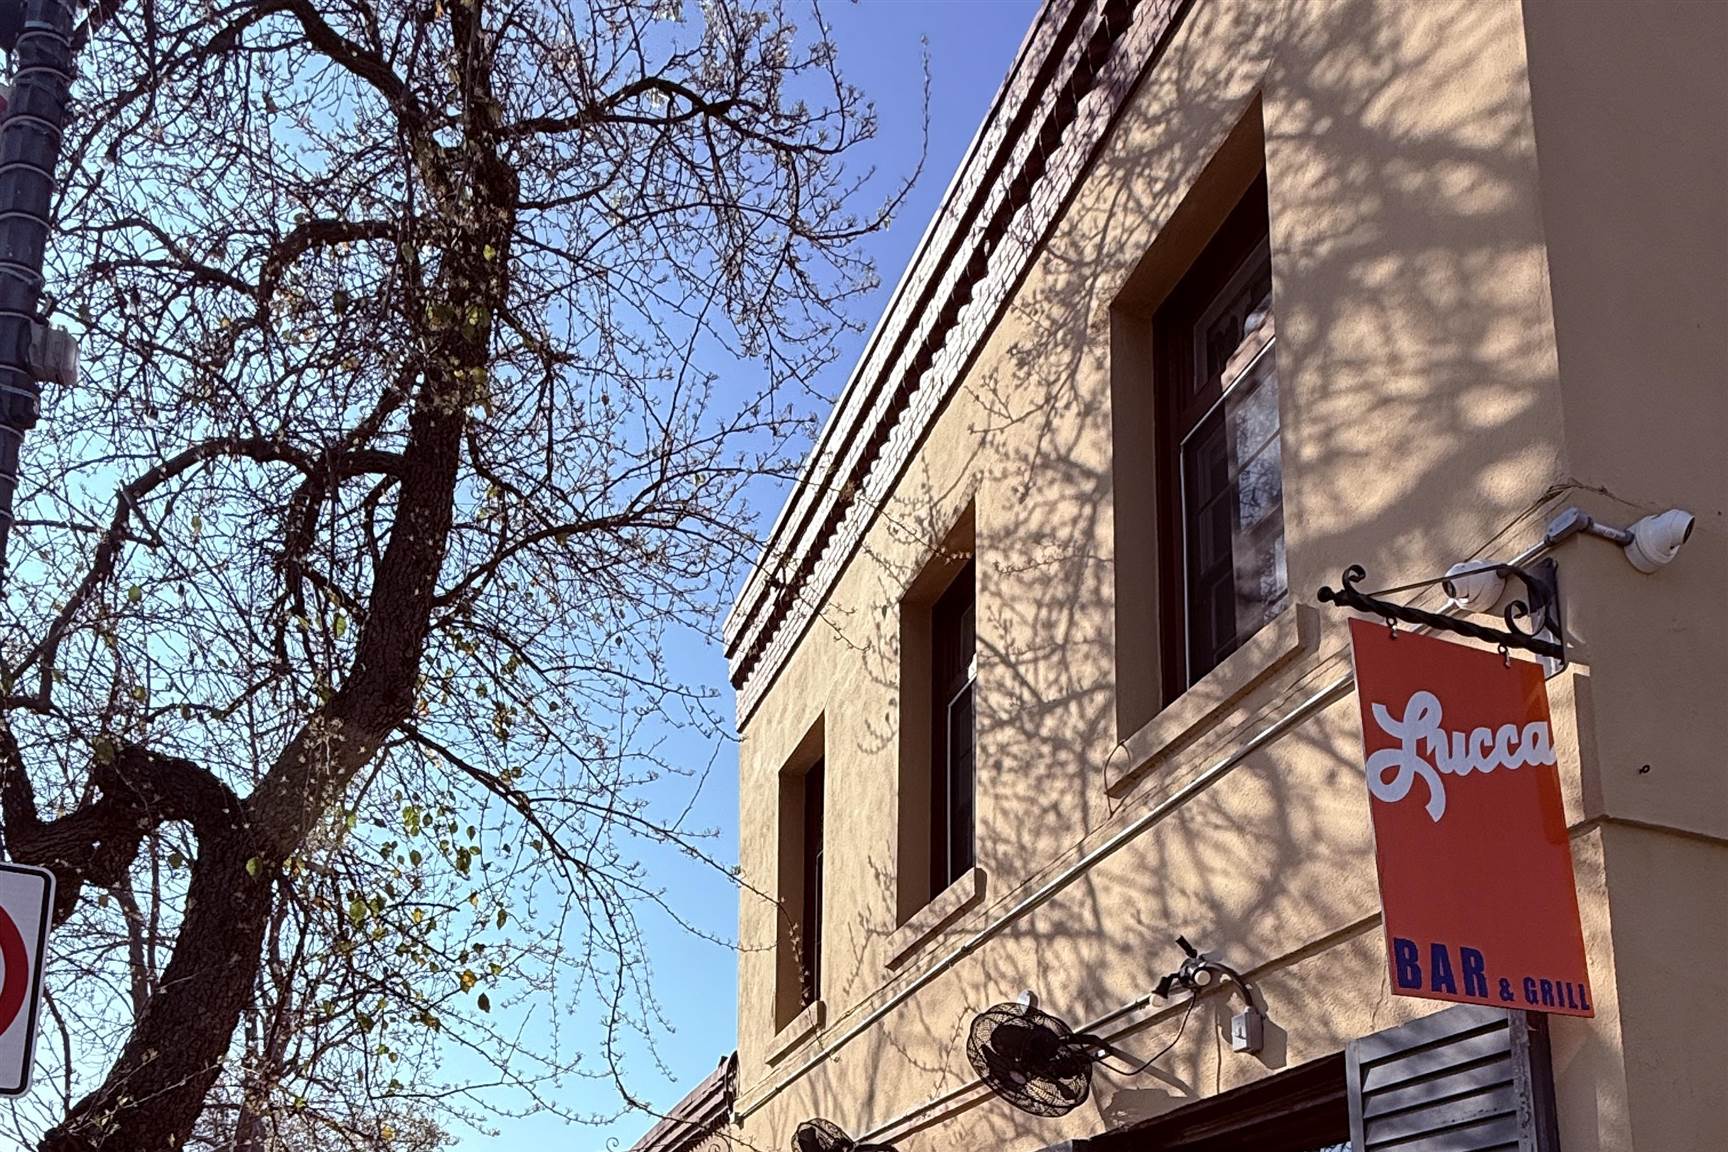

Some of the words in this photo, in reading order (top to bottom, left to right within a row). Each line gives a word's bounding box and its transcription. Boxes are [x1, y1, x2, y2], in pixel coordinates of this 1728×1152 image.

[1365, 690, 1557, 823] Lucca
[1393, 937, 1489, 998] BAR
[1499, 978, 1514, 1002] &
[1523, 977, 1590, 1011] GRILL
